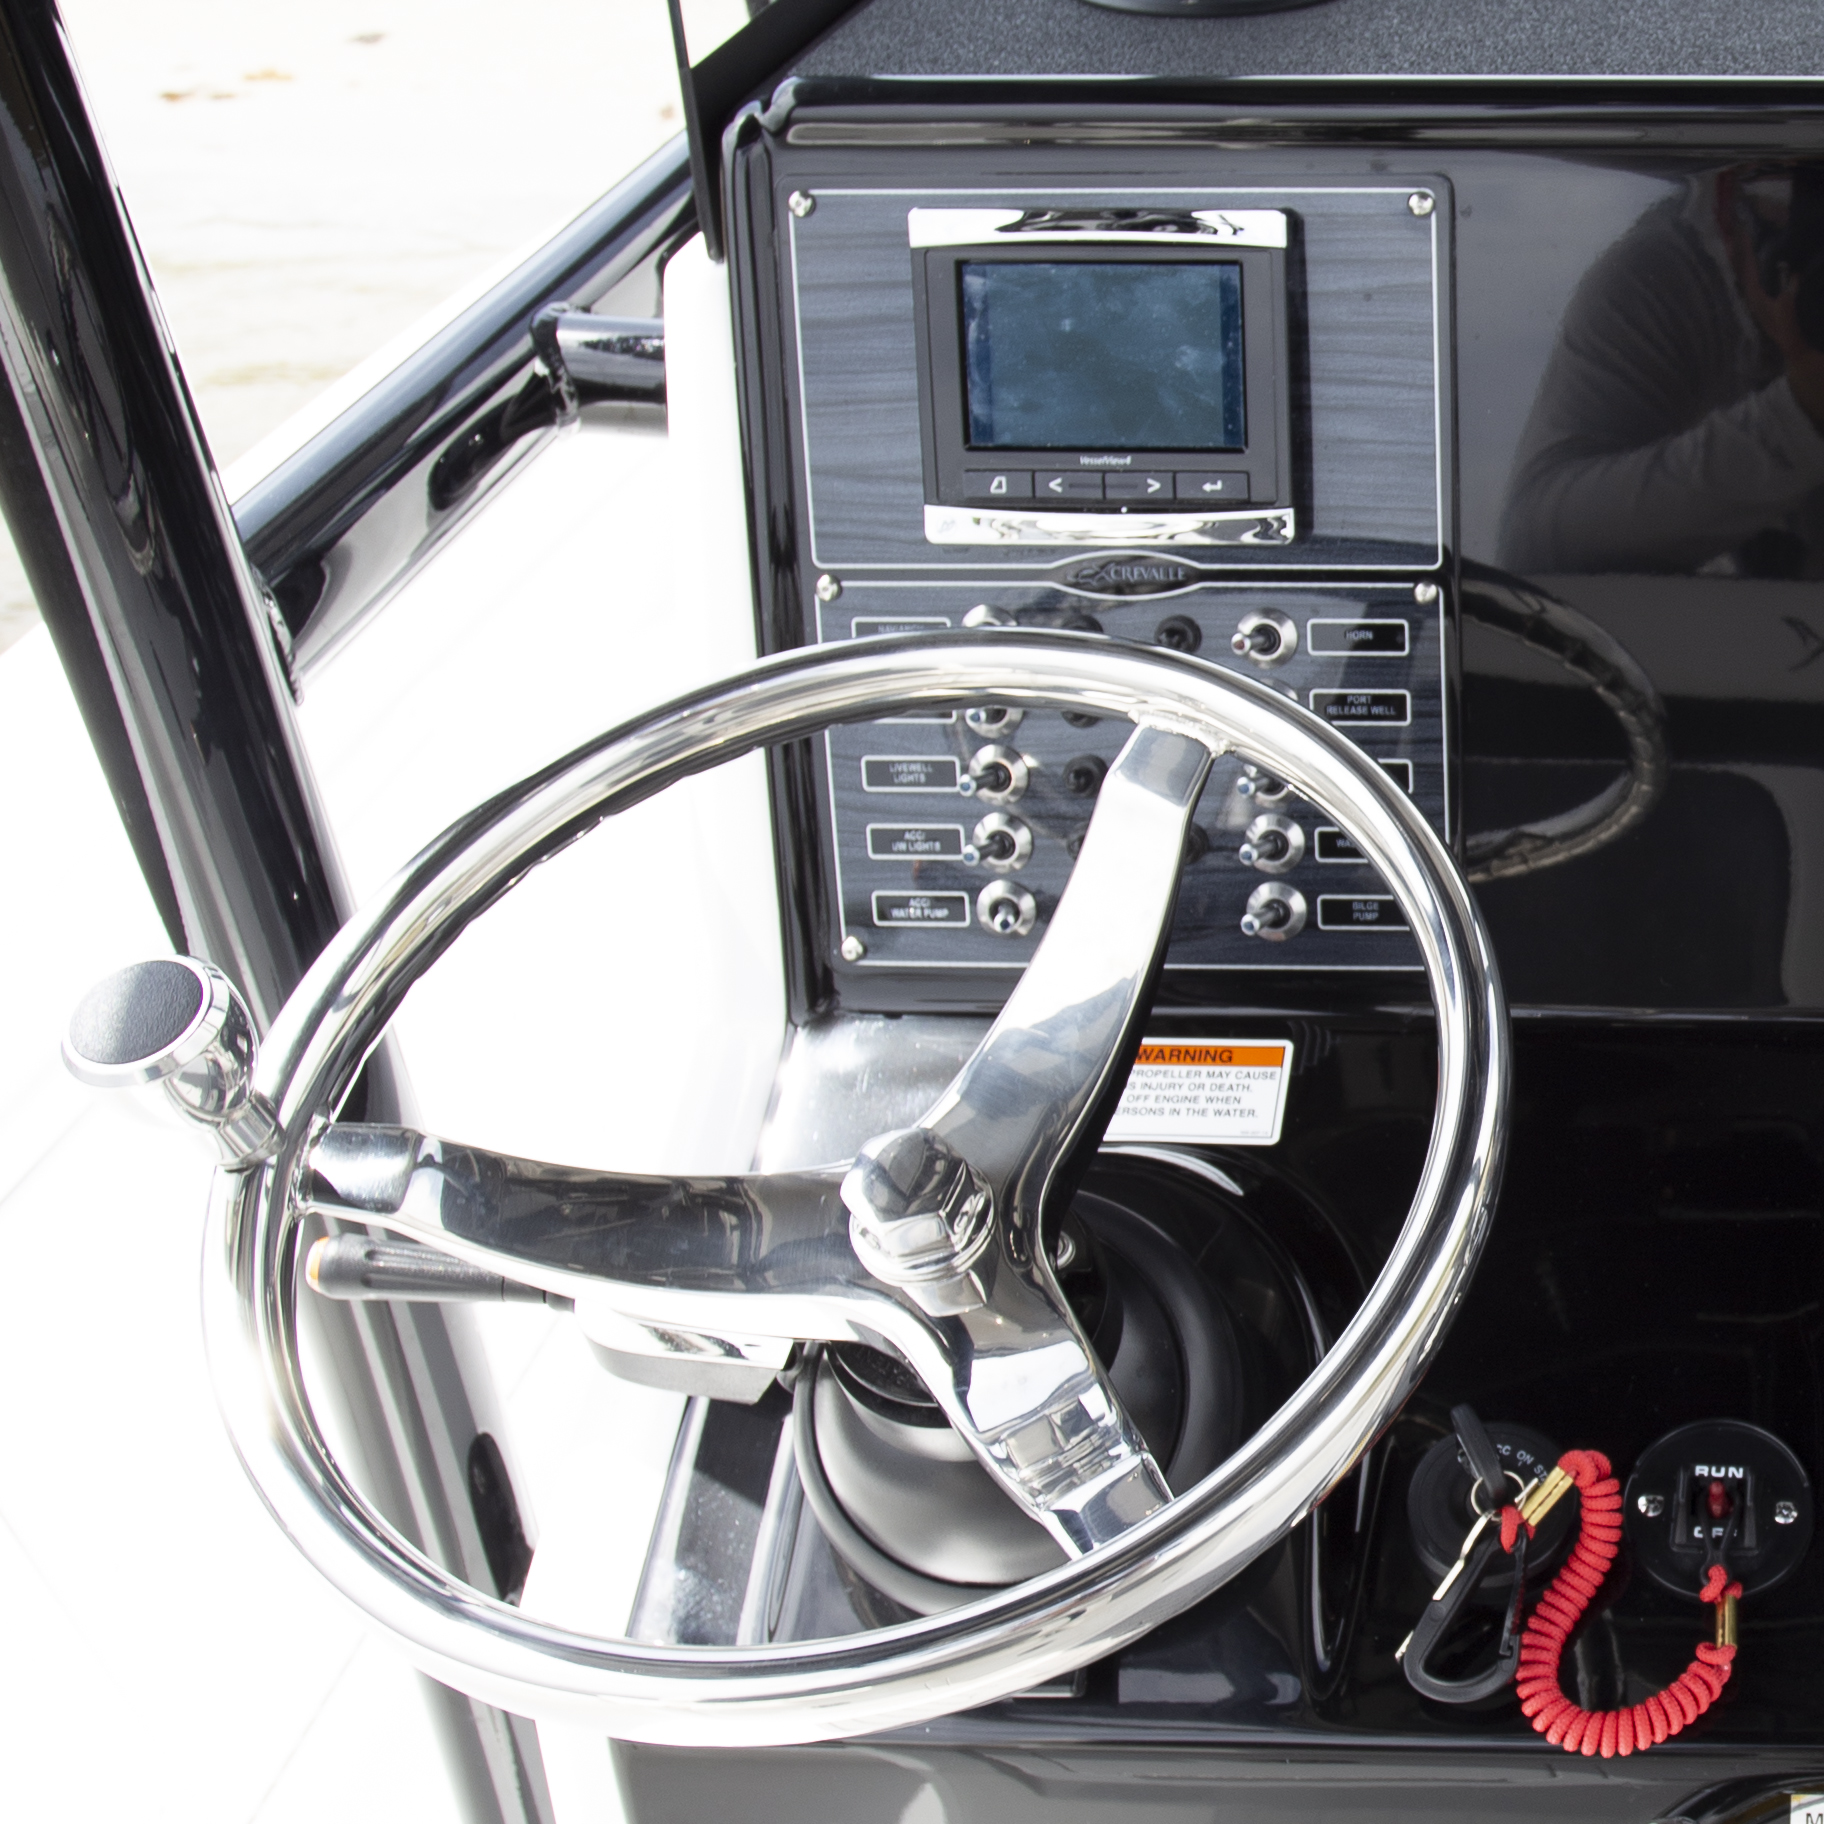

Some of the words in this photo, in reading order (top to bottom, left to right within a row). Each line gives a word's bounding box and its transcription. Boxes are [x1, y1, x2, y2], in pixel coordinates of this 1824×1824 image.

[1110, 565, 1186, 583] CREVALLE
[1346, 630, 1373, 640] HORN
[1347, 695, 1371, 704] PORT
[1327, 705, 1368, 715] RELEASE
[1371, 706, 1396, 715] WELL
[889, 762, 933, 773] LIVEWELL
[893, 773, 926, 783] LIGHTS
[1352, 902, 1379, 911] BILGE
[924, 908, 949, 918] PUMP
[1353, 912, 1378, 921] PUMP
[1136, 1048, 1233, 1064] WARNING
[1205, 1070, 1231, 1080] MAY
[1235, 1071, 1277, 1080] CAUSE
[1140, 1082, 1183, 1091] INJURY
[1188, 1082, 1206, 1091] OR
[1209, 1083, 1253, 1092] DEATH.
[1126, 1094, 1150, 1103] OFF
[1154, 1094, 1201, 1104] ENGINE
[1205, 1095, 1241, 1105] WHEN
[1115, 1106, 1165, 1116] ERSONS
[1169, 1107, 1180, 1116] IN
[1186, 1107, 1208, 1117] THE
[1213, 1108, 1258, 1118] WATER.
[1517, 1450, 1534, 1465] ON
[1695, 1465, 1744, 1479] RUN
